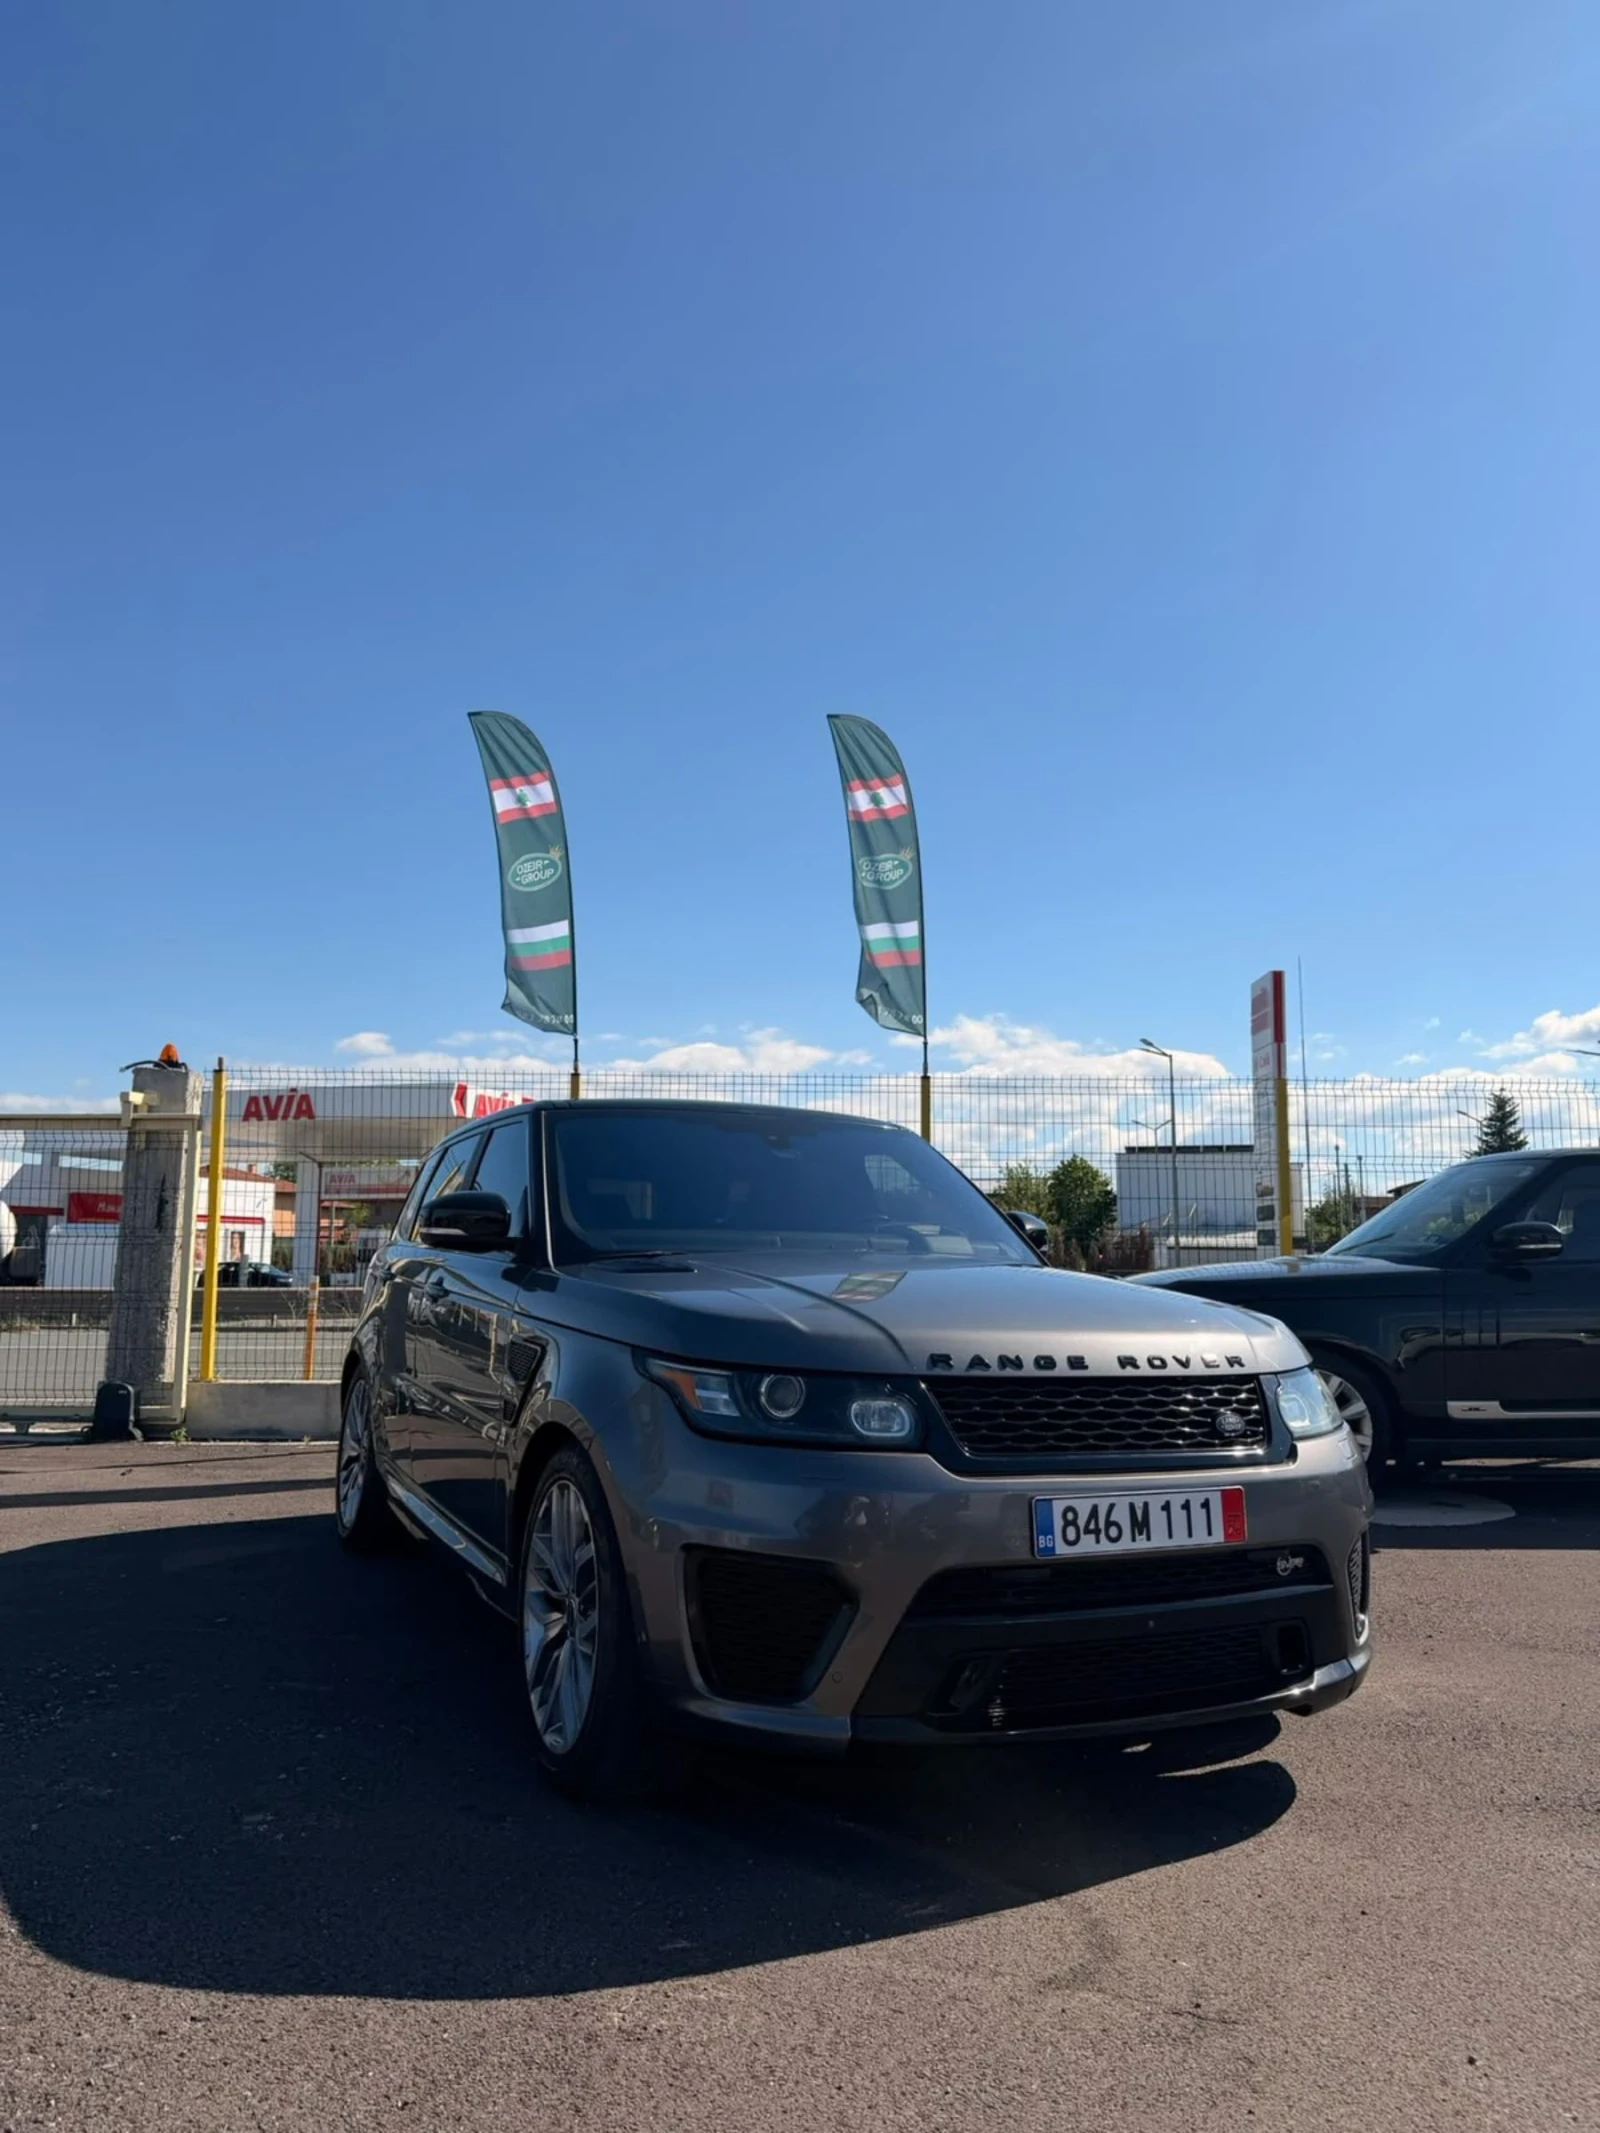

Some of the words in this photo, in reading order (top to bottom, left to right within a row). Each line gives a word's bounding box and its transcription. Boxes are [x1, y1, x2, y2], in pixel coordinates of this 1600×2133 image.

[926, 1352, 1089, 1371] RANGE
[1116, 1354, 1246, 1371] ROVER
[1038, 1535, 1054, 1548] BG
